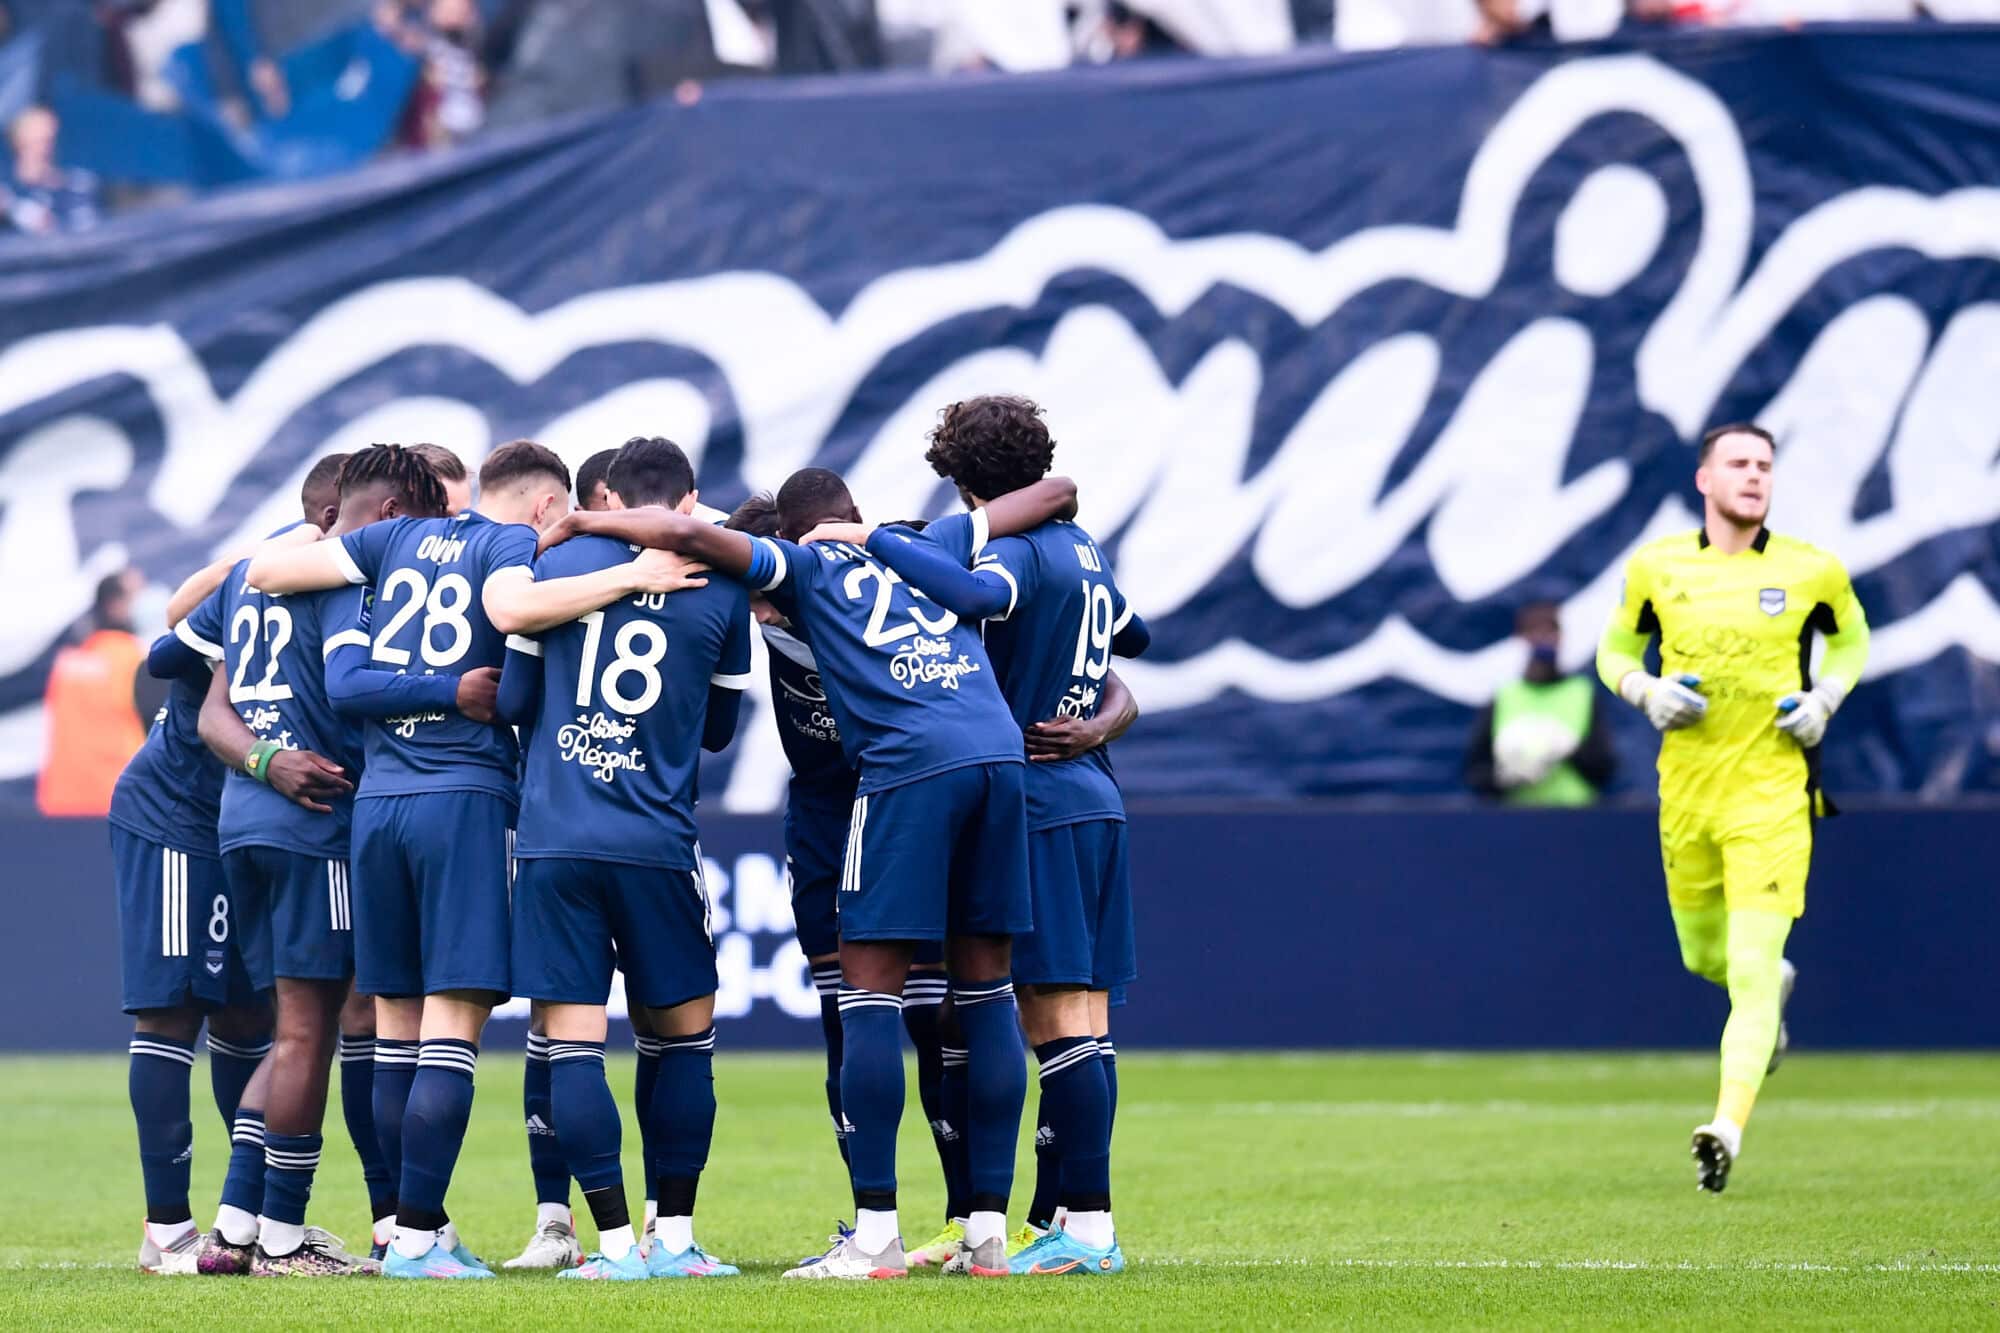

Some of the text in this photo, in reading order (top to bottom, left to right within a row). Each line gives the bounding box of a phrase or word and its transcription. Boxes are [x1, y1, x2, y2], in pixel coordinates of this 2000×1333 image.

[229, 604, 294, 704] 22
[371, 567, 472, 667] 28
[576, 611, 668, 715] 18
[1072, 579, 1113, 680] 19
[208, 894, 229, 943] 8
